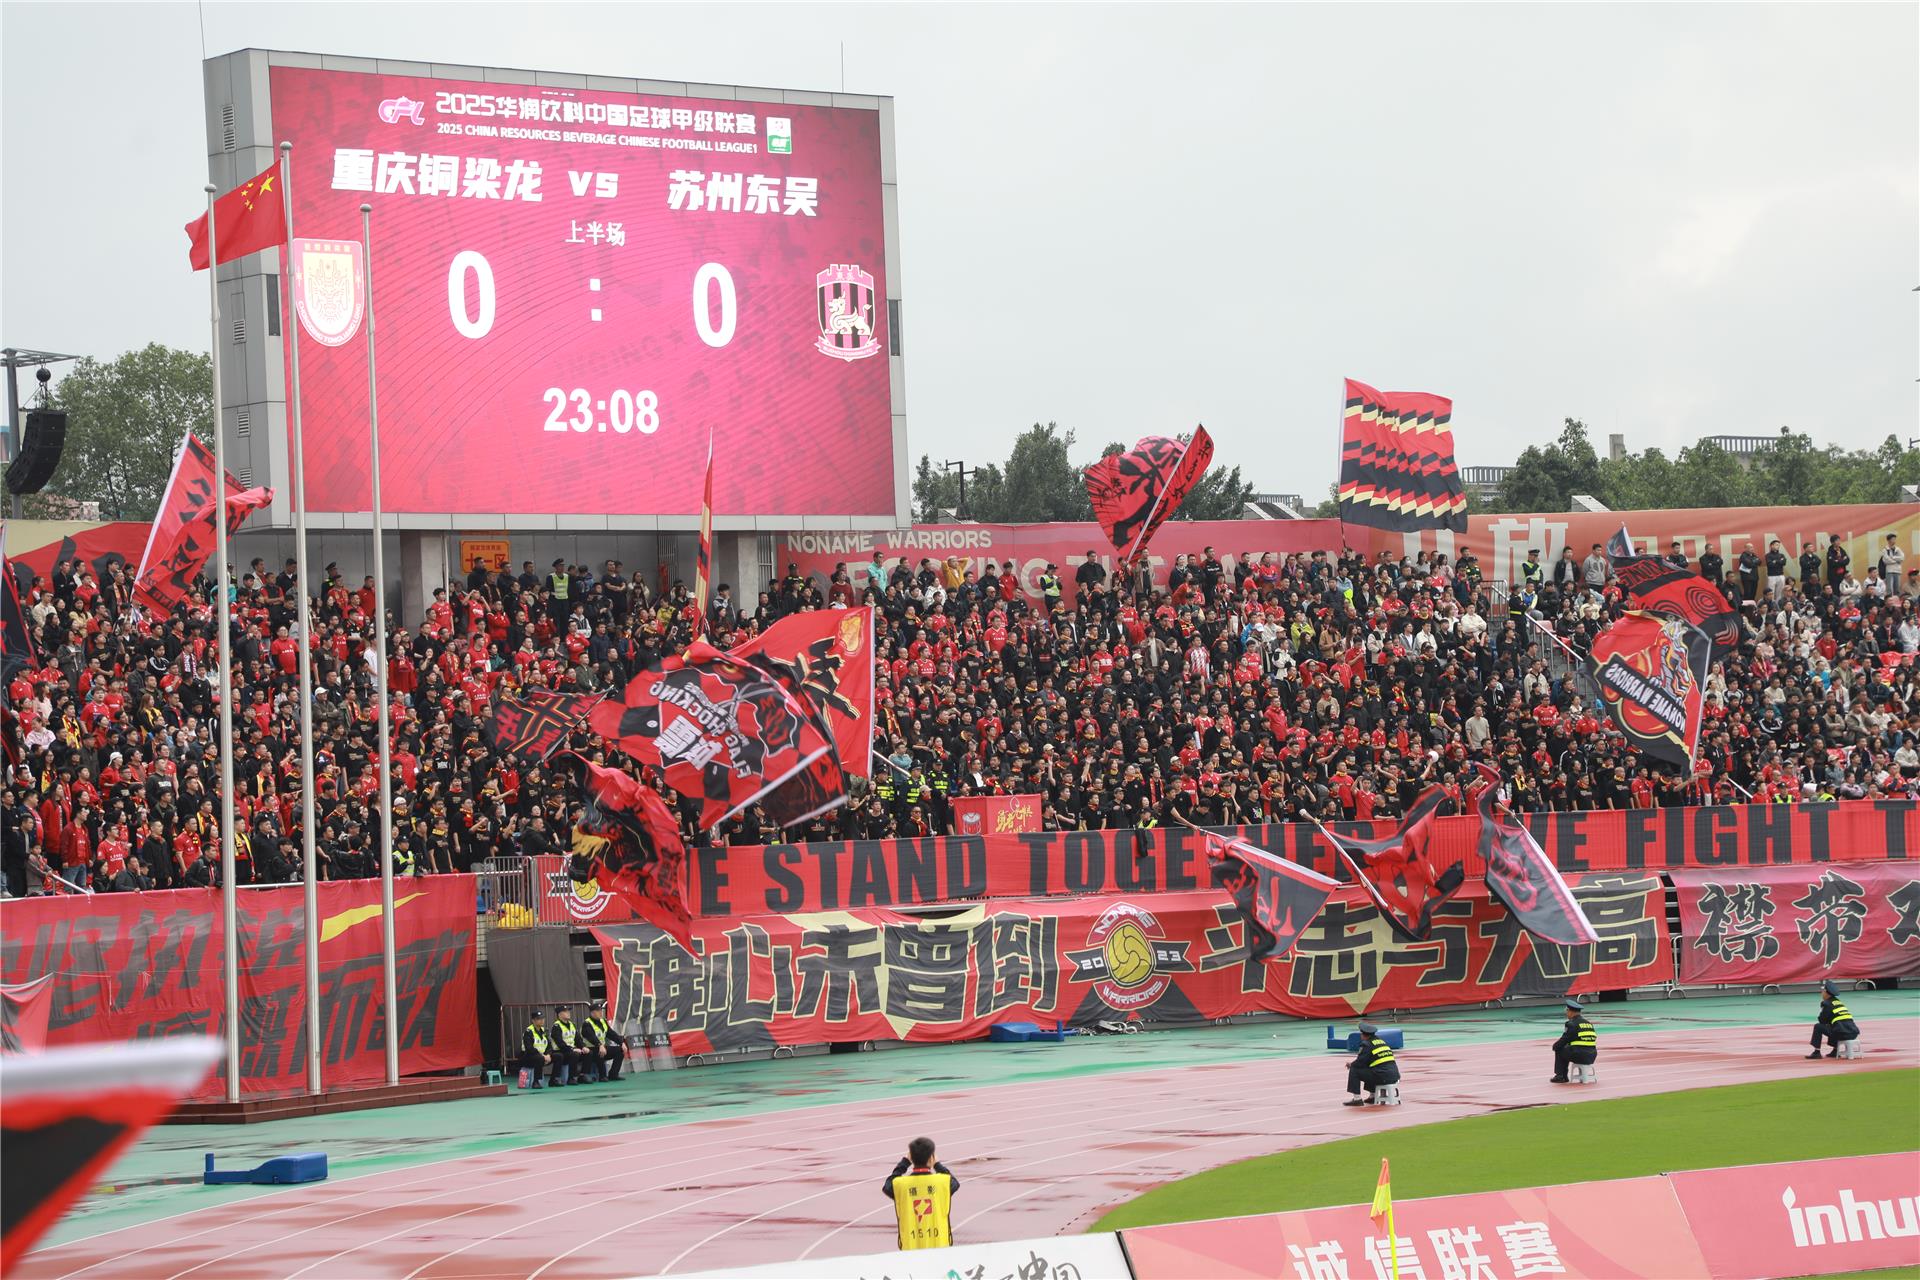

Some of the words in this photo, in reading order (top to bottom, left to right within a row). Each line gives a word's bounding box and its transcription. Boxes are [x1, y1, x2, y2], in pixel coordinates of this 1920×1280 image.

[437, 123, 463, 135] 2025
[465, 125, 498, 137] CHINA
[500, 127, 561, 141] RESOURCES
[563, 131, 617, 145] BEVERAGE
[618, 134, 660, 148] CHINESE
[662, 137, 713, 151] FOOTBALL
[331, 148, 543, 202] 重庆铜梁龙
[667, 169, 818, 217] 苏州东吴
[565, 220, 625, 247] 上半场
[448, 250, 496, 339] 0
[692, 262, 737, 348] 0
[543, 387, 660, 434] 23:08
[787, 534, 875, 554] NONAME
[887, 530, 992, 551] WARRIORS
[763, 834, 988, 912] STAND
[1625, 801, 1839, 867] FIGHT
[910, 1228, 939, 1239] 1510
[1782, 1185, 1920, 1249] inhu
[1287, 1220, 1567, 1280] 诚信联赛
